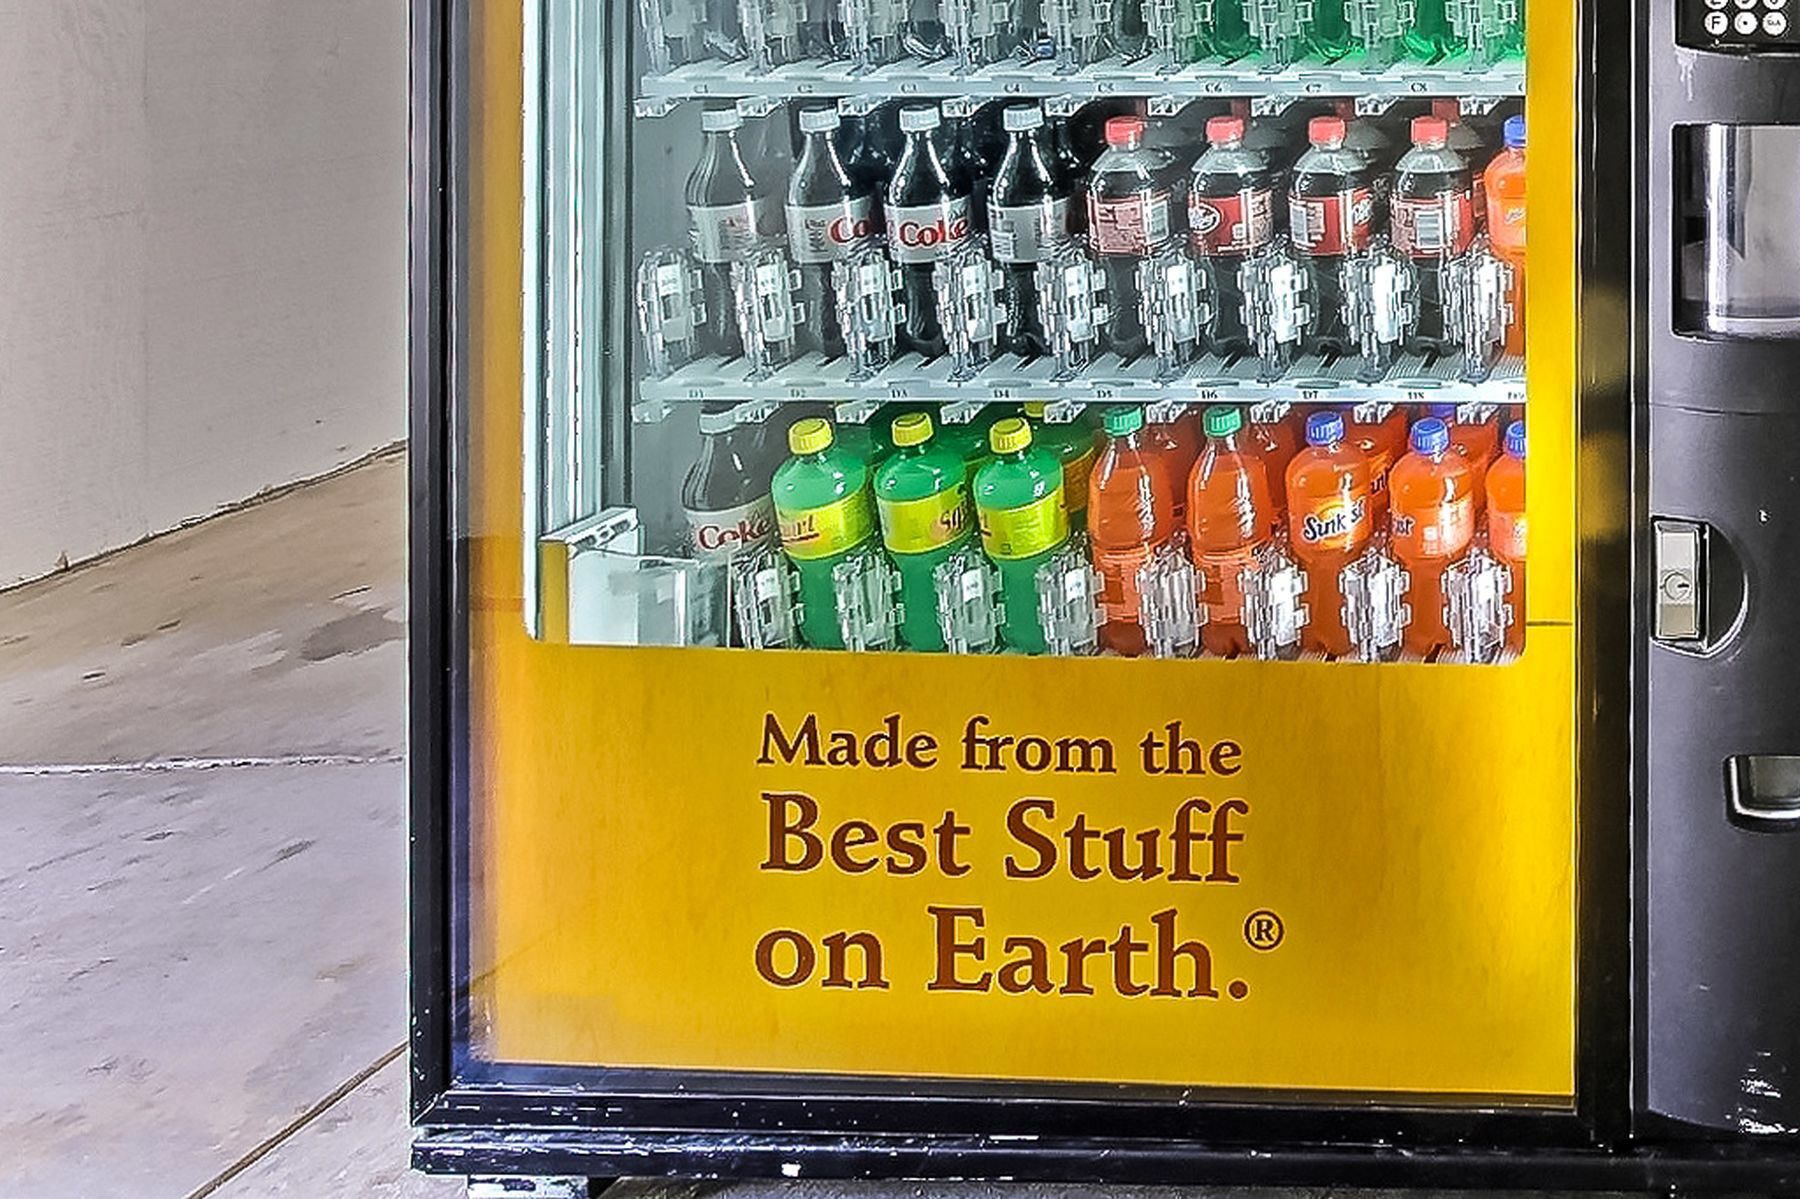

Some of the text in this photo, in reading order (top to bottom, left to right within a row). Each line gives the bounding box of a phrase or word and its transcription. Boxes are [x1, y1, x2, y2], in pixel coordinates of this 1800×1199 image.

[1711, 17, 1722, 29] F
[1205, 82, 1222, 93] C6
[1411, 81, 1428, 92] C8
[899, 215, 969, 247] Coke
[1302, 390, 1319, 399] D7
[1303, 499, 1366, 540] Sunkst
[757, 713, 1242, 776] Made from the
[760, 792, 1250, 884] Best Stuff
[754, 928, 890, 990] on
